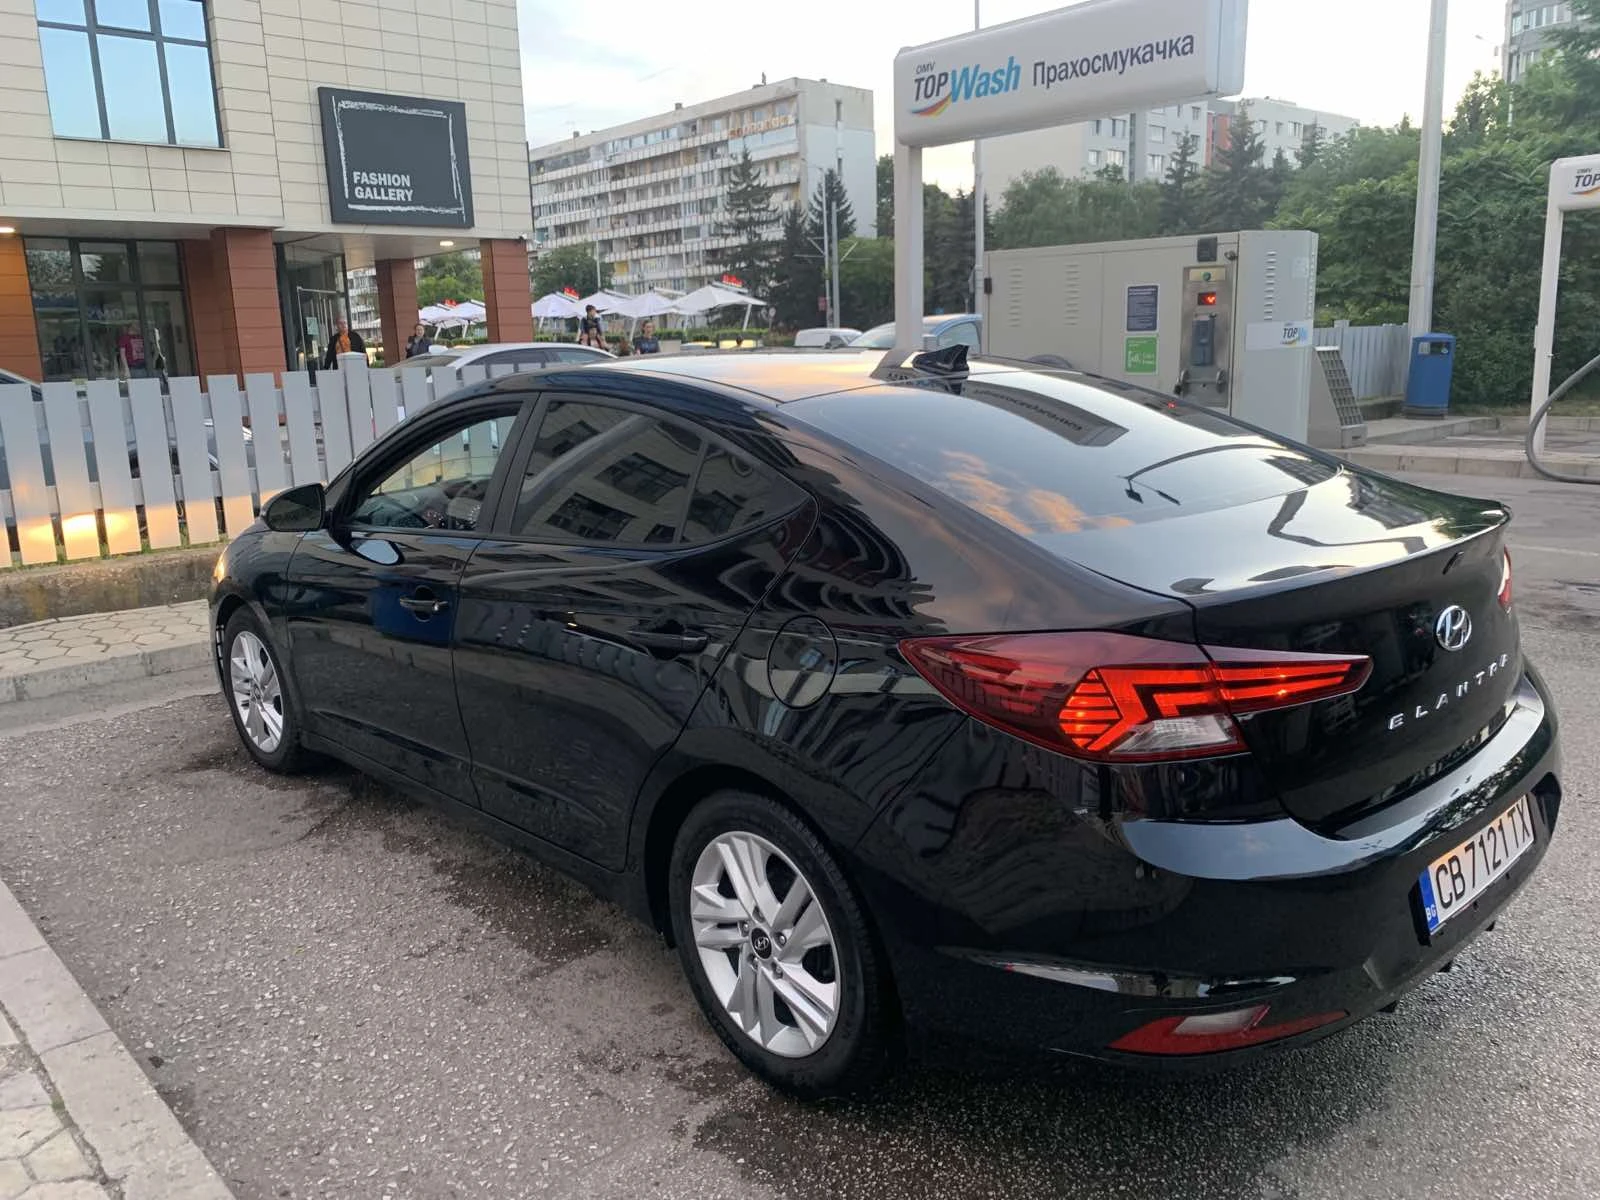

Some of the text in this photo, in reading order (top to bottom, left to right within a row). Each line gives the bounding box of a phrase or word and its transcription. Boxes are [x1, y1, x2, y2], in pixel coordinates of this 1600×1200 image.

[915, 61, 936, 75] OMV
[1032, 33, 1195, 90] Прахосмукачка
[352, 171, 412, 188] FASHION
[354, 186, 414, 202] GALLERY
[1425, 904, 1437, 921] BG
